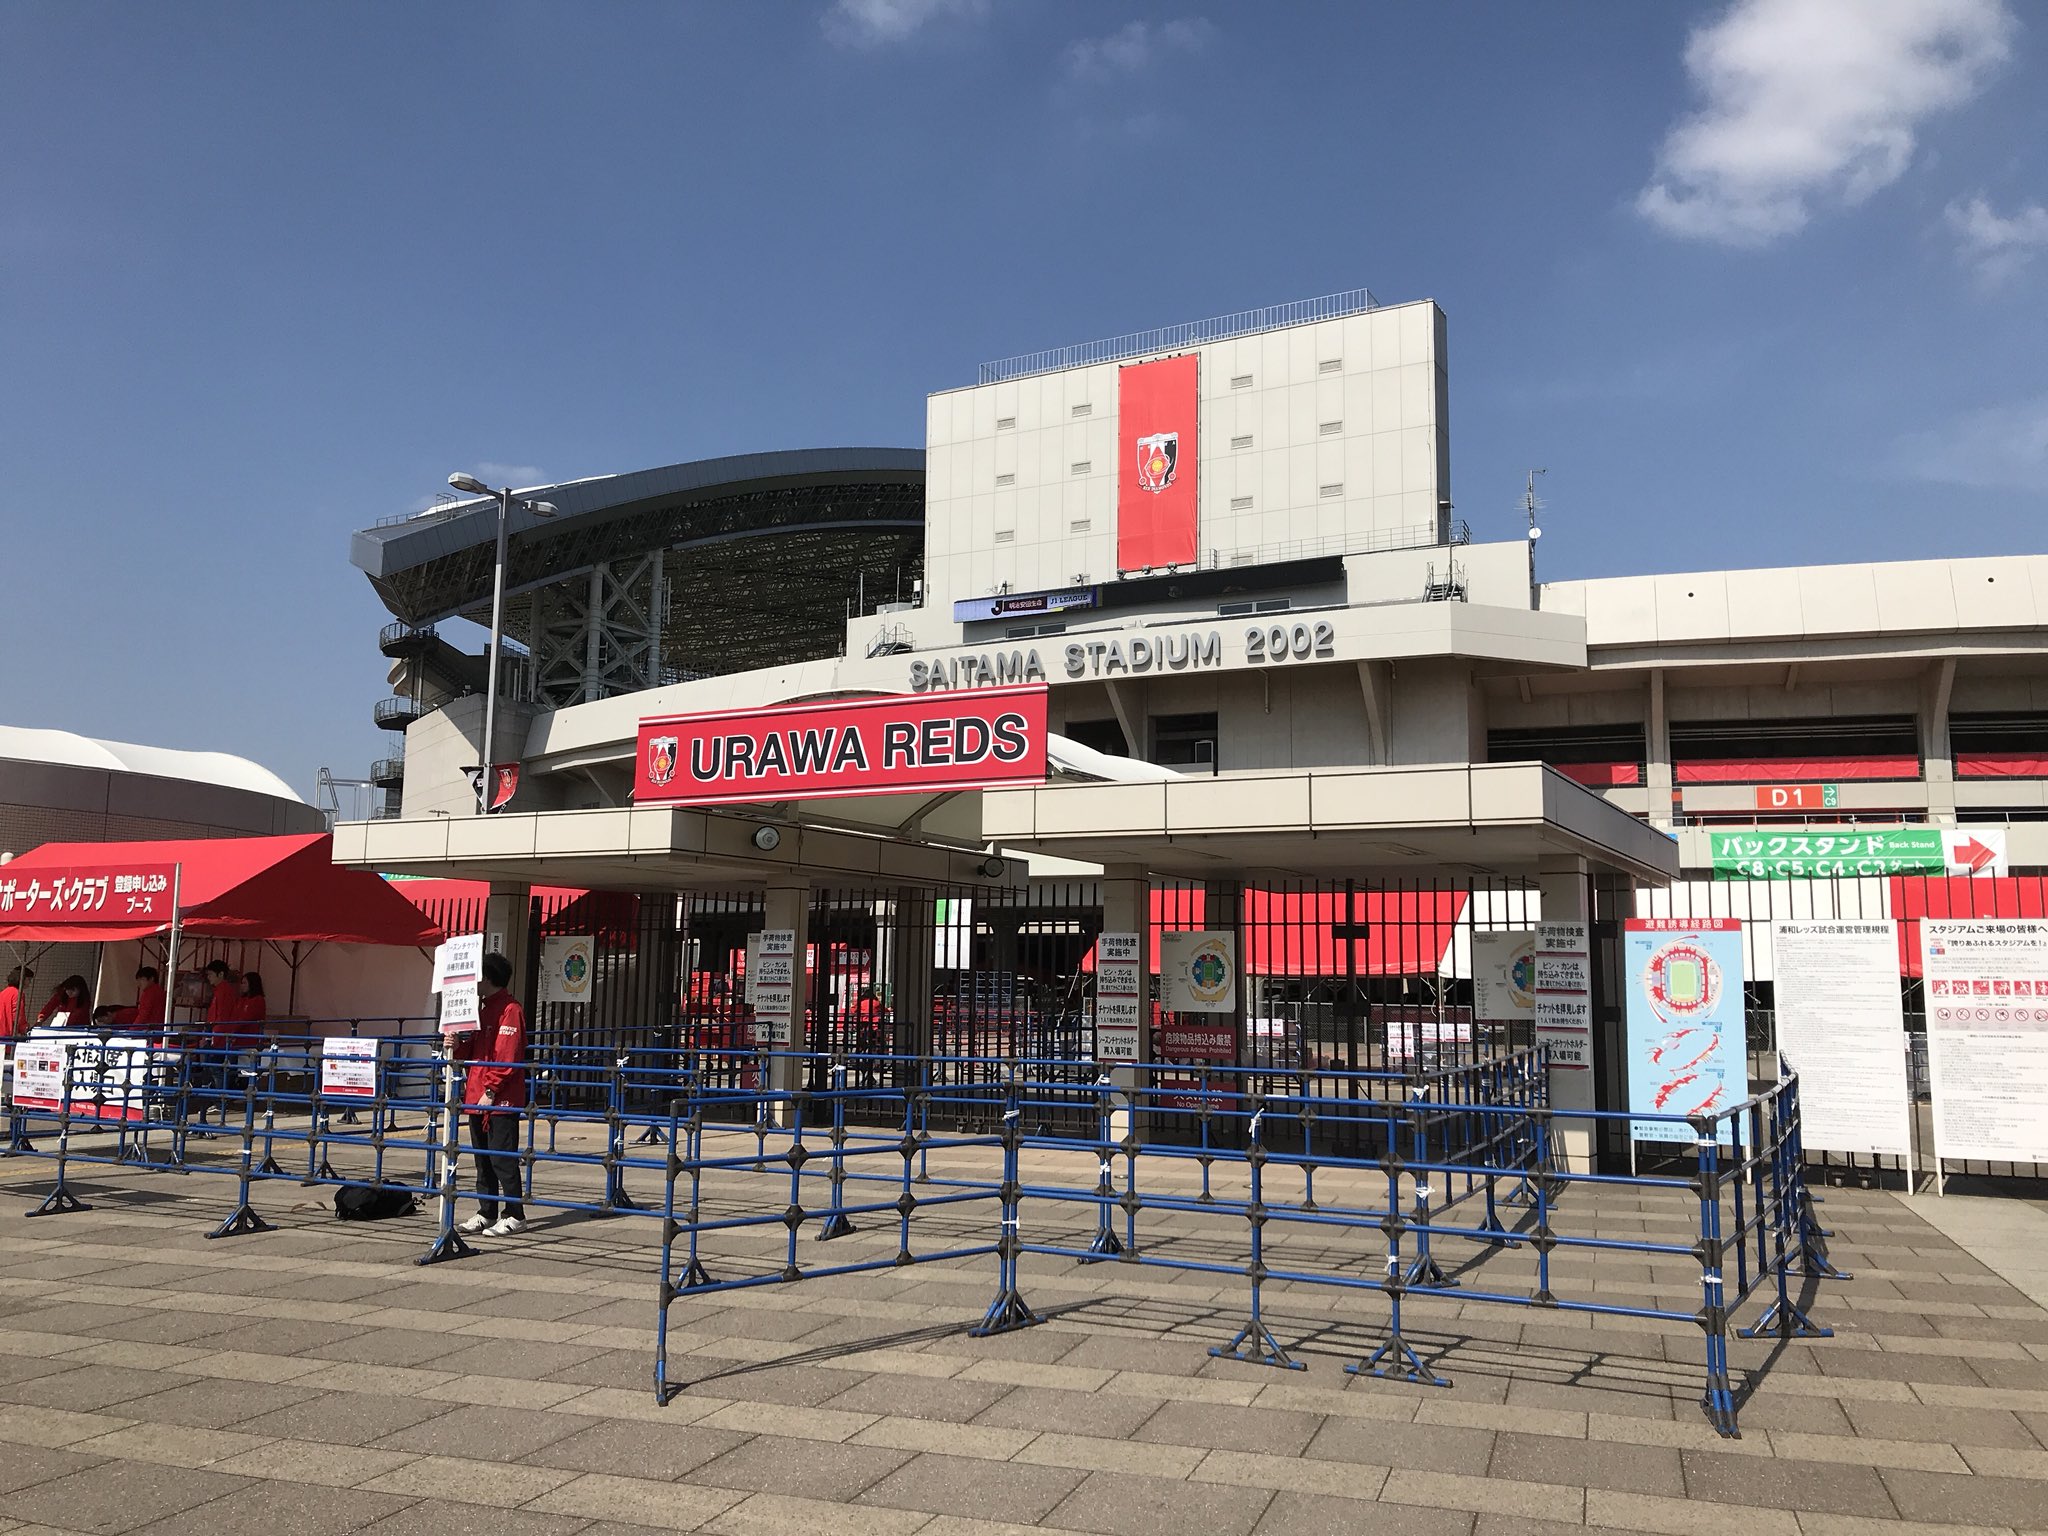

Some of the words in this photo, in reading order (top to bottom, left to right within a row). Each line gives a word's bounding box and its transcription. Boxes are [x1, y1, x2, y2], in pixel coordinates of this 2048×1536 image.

[1060, 595, 1088, 604] LEAGUE
[909, 648, 1046, 691] SAITAMA
[1064, 631, 1220, 675] STADIUM
[1244, 620, 1335, 657] 2002
[691, 725, 867, 782] URAWA
[883, 713, 1029, 768] REDS
[1825, 797, 1837, 806] C9
[1721, 835, 1885, 856] バックスタンド
[1889, 841, 1909, 849] Back
[1911, 840, 1935, 849] Stand
[0, 876, 109, 912] ポーターズ・クラブ
[114, 874, 167, 893] 登録申し込み
[126, 896, 153, 914] ブース
[1645, 919, 1723, 929] 避難誘導経路図
[1538, 926, 1584, 937] 手荷物検査
[1779, 925, 1890, 934] 浦和レッズ試合運営管理規程
[1929, 925, 2048, 934] スタジアムご来場の皆様へ
[763, 933, 792, 942] 手荷物検査
[1101, 937, 1137, 947] 手荷物検査
[767, 943, 787, 951] 実施中
[1545, 939, 1576, 949] 実施中
[1106, 948, 1131, 957] 実施中
[1165, 1031, 1232, 1046] 危険物品持込み厳禁
[1103, 1046, 1132, 1056] 再入場可能
